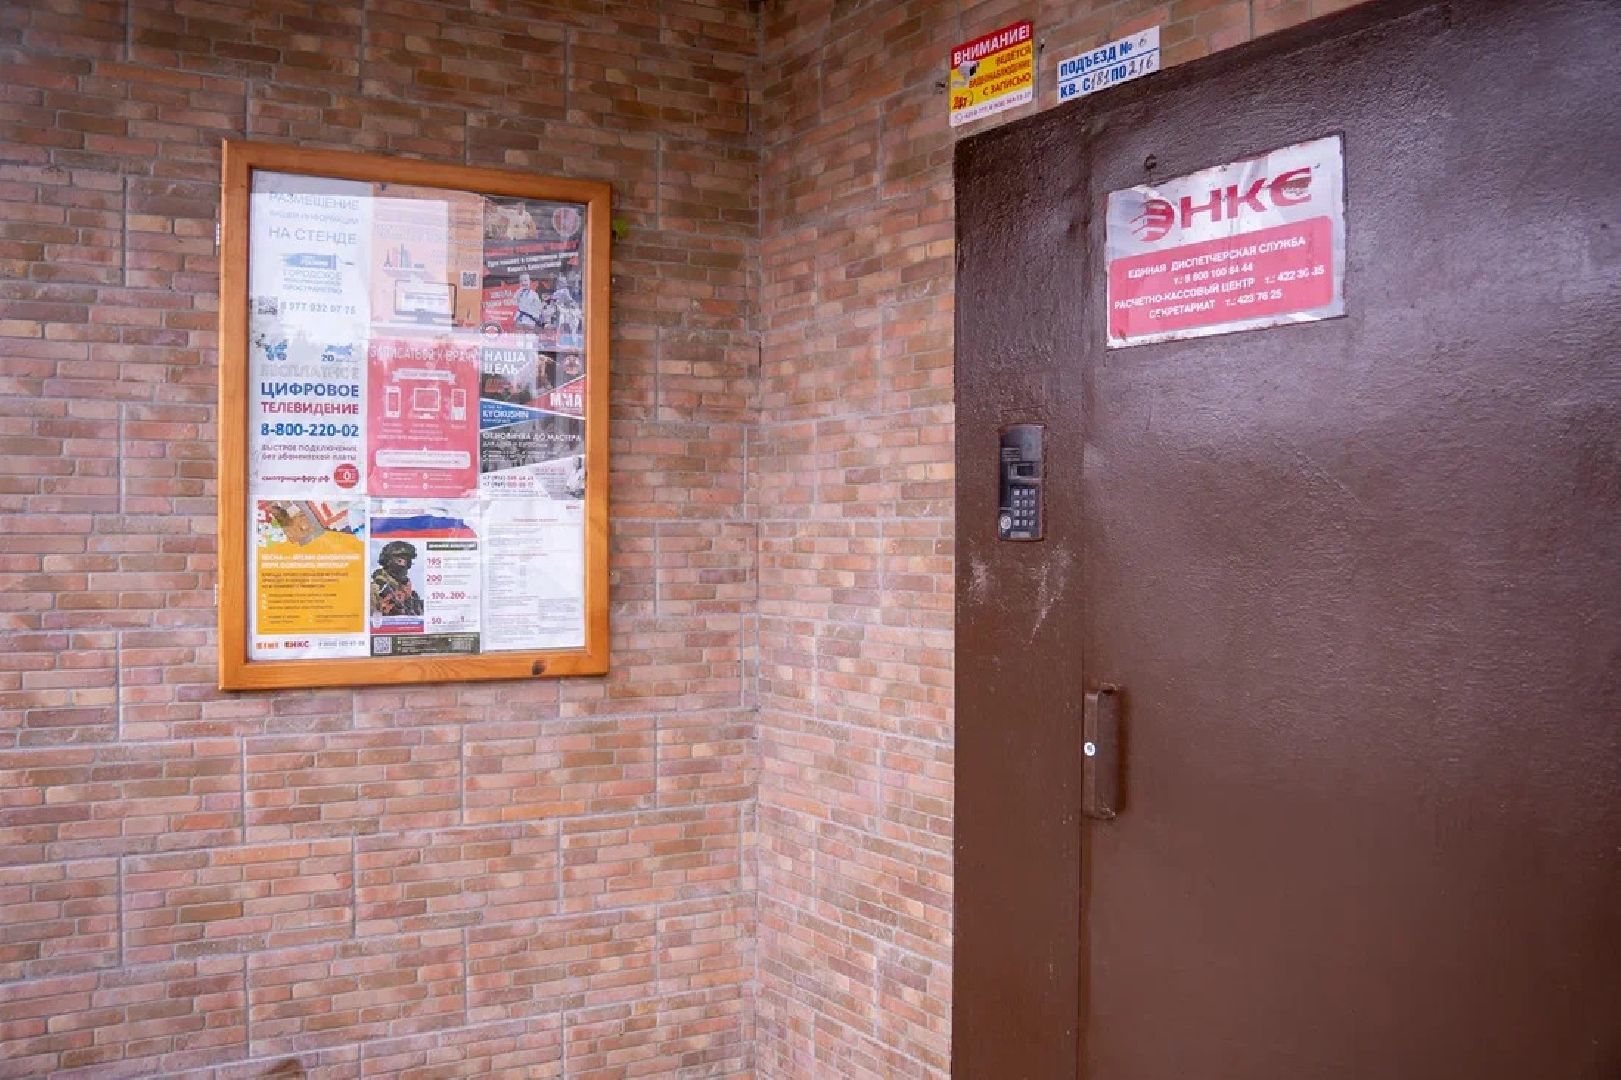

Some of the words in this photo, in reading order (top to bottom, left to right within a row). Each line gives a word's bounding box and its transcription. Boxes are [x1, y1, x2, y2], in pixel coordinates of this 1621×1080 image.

[954, 25, 1030, 66] ВНИМАНИЕ!
[1061, 47, 1116, 76] ПОДЪЕЗД
[1060, 84, 1080, 98] КВ.
[1111, 66, 1127, 83] ПО
[269, 191, 360, 210] РАЗМЕЩЕНИЕ
[269, 227, 290, 241] НА
[294, 228, 359, 247] СТЕНДЕ
[1128, 263, 1167, 279] ЕДИННАЯ
[1171, 247, 1257, 272] ДИСПЕТЧЕРСКАЯ
[1258, 237, 1305, 254] СЛУЖБА
[1114, 281, 1220, 309] РАСЧЕТНО-КАССОВЫЙ
[1222, 276, 1256, 294] ЦЕНТР
[1149, 299, 1215, 320] СЕКРЕТАРИАТ
[484, 350, 526, 362] НАША
[484, 363, 519, 377] ЦЕЛЬ
[261, 382, 359, 399] ЦИФРОВОЕ
[261, 402, 359, 416] ТЕЛЕВИДЕНИЕ
[261, 423, 360, 437] 8-800-220-02
[426, 574, 442, 582] 200
[450, 591, 465, 599] 200
